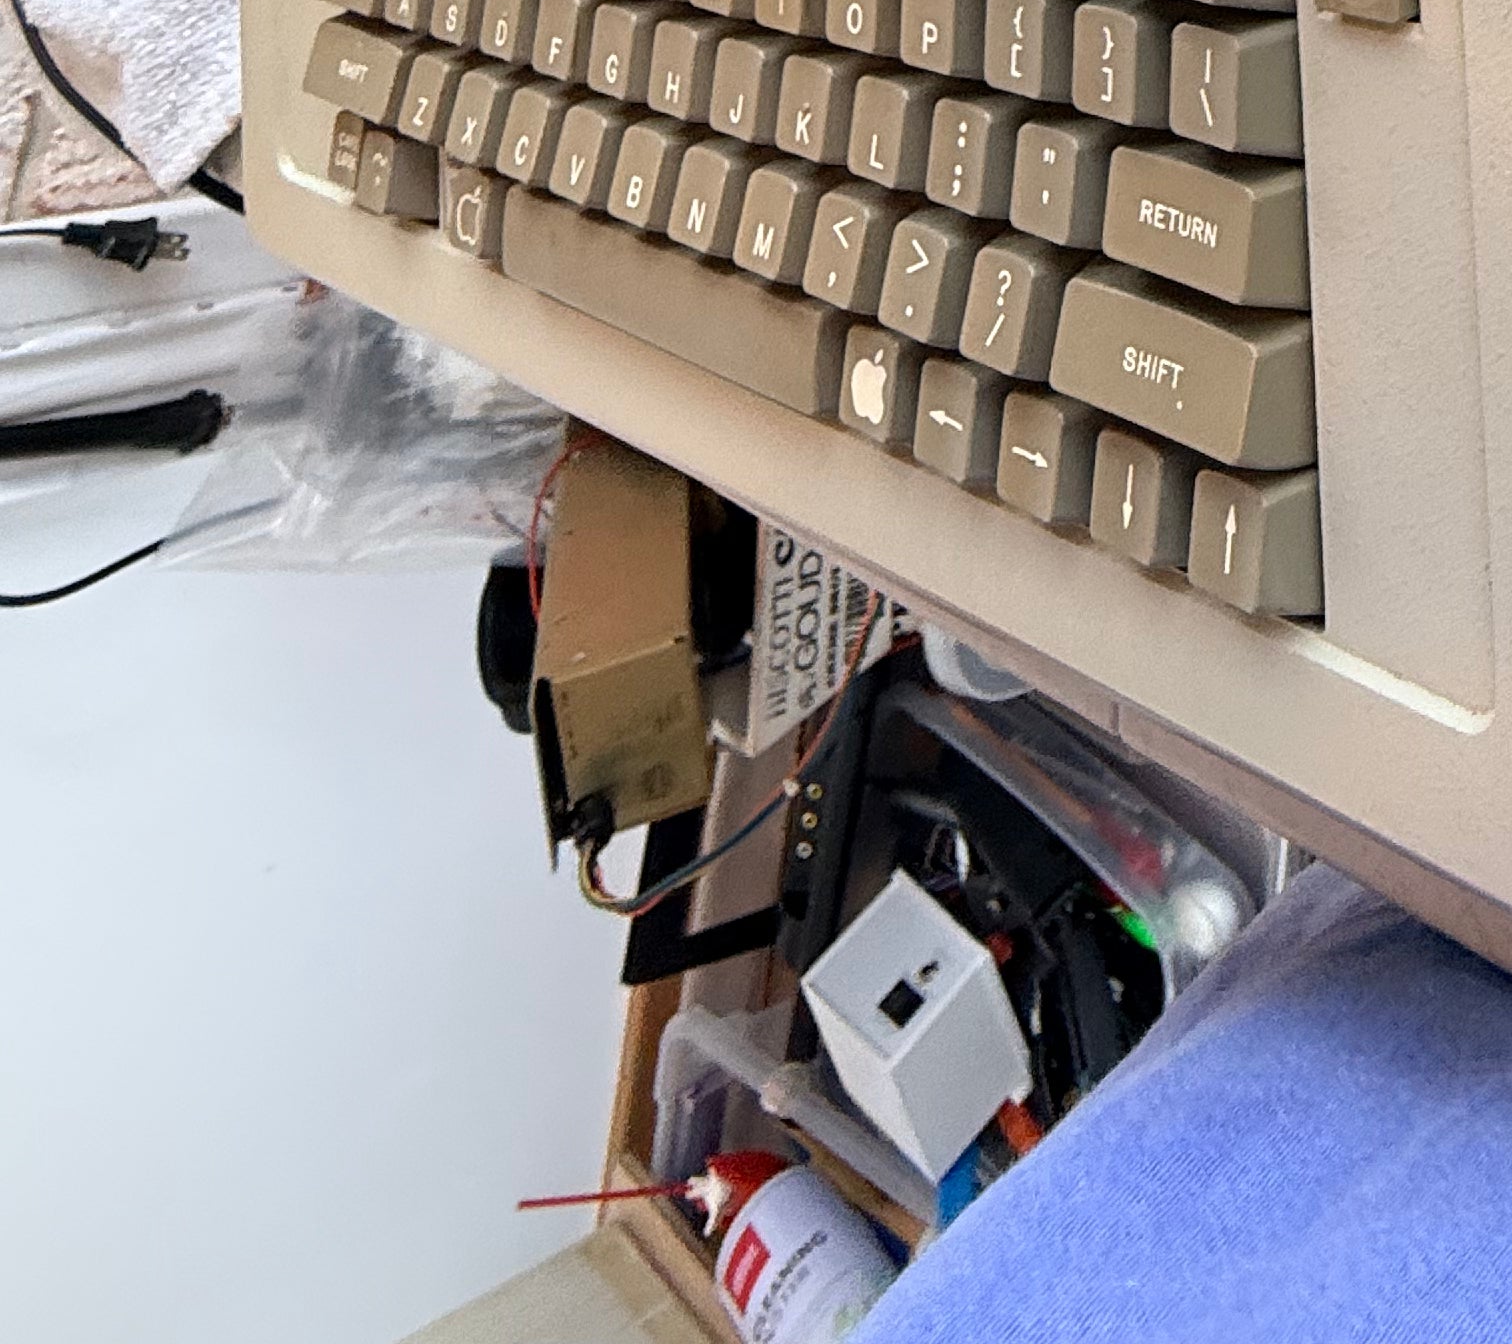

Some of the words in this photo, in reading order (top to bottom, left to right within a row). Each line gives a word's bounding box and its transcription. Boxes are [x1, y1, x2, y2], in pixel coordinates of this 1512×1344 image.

[445, 4, 458, 32] S
[494, 19, 508, 47] D
[846, 2, 863, 35] O
[548, 36, 563, 65] F
[921, 21, 938, 54] P
[605, 53, 619, 84] G
[664, 71, 681, 104] H
[412, 96, 429, 127] Z
[729, 93, 744, 124] J
[460, 116, 478, 146] X
[794, 110, 812, 145] K
[514, 134, 530, 166] C
[869, 133, 884, 170] L
[570, 154, 586, 186] V
[625, 175, 644, 209] B
[686, 198, 707, 234] N
[1138, 198, 1218, 248] RETURN
[752, 222, 775, 260] M
[996, 269, 1012, 307] ?
[1122, 346, 1185, 389] SHIFT
